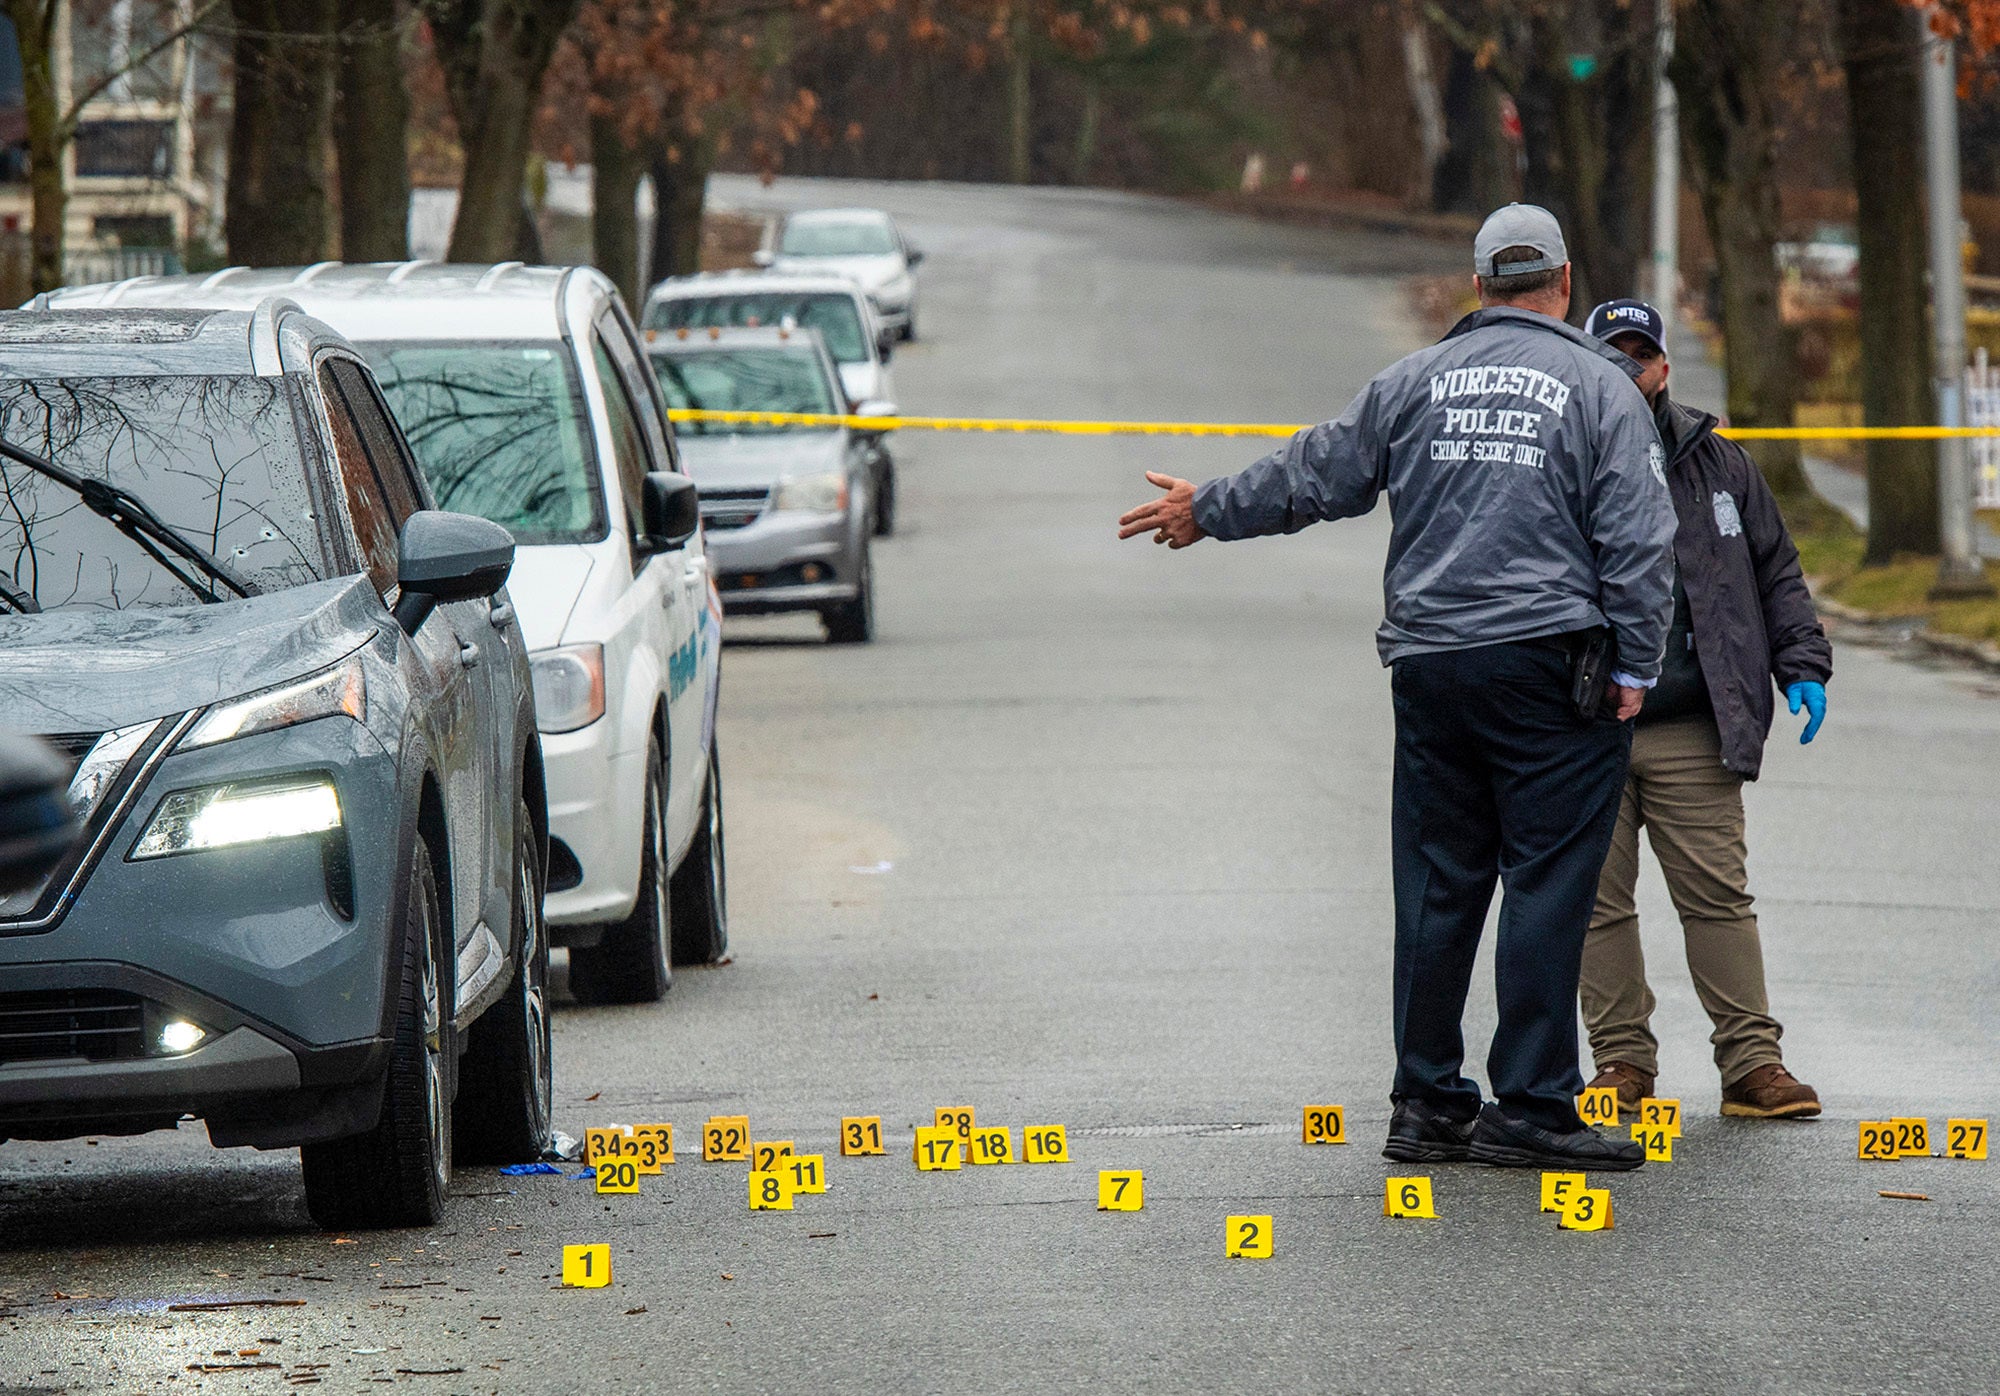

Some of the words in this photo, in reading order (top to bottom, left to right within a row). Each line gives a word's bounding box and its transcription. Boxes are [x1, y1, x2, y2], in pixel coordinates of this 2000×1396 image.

[1607, 306, 1649, 321] UNITED
[1430, 365, 1570, 418] WORCESTER
[1443, 408, 1542, 438] POLICE
[1430, 440, 1469, 460] CRIME
[1473, 440, 1513, 463] SCENE
[1515, 443, 1547, 468] UNIT
[1583, 1095, 1613, 1118] 40
[847, 1123, 879, 1148] 31
[1309, 1112, 1340, 1137] 30
[1898, 1124, 1926, 1150] 28
[591, 1134, 621, 1158] 34
[708, 1128, 740, 1154] 32
[975, 1134, 1007, 1157] 18
[1030, 1132, 1062, 1155] 16
[1635, 1131, 1667, 1154] 14
[1863, 1129, 1895, 1155] 29
[1951, 1126, 1983, 1151] 27
[922, 1140, 954, 1163] 17
[600, 1163, 635, 1187] 20
[790, 1162, 816, 1185] 11
[762, 1178, 780, 1202] 8
[1111, 1177, 1130, 1202] 7
[1400, 1184, 1420, 1209] 6
[1553, 1181, 1571, 1205] 5
[1574, 1196, 1594, 1221] 3
[1239, 1223, 1258, 1248] 2
[579, 1251, 593, 1277] 1
